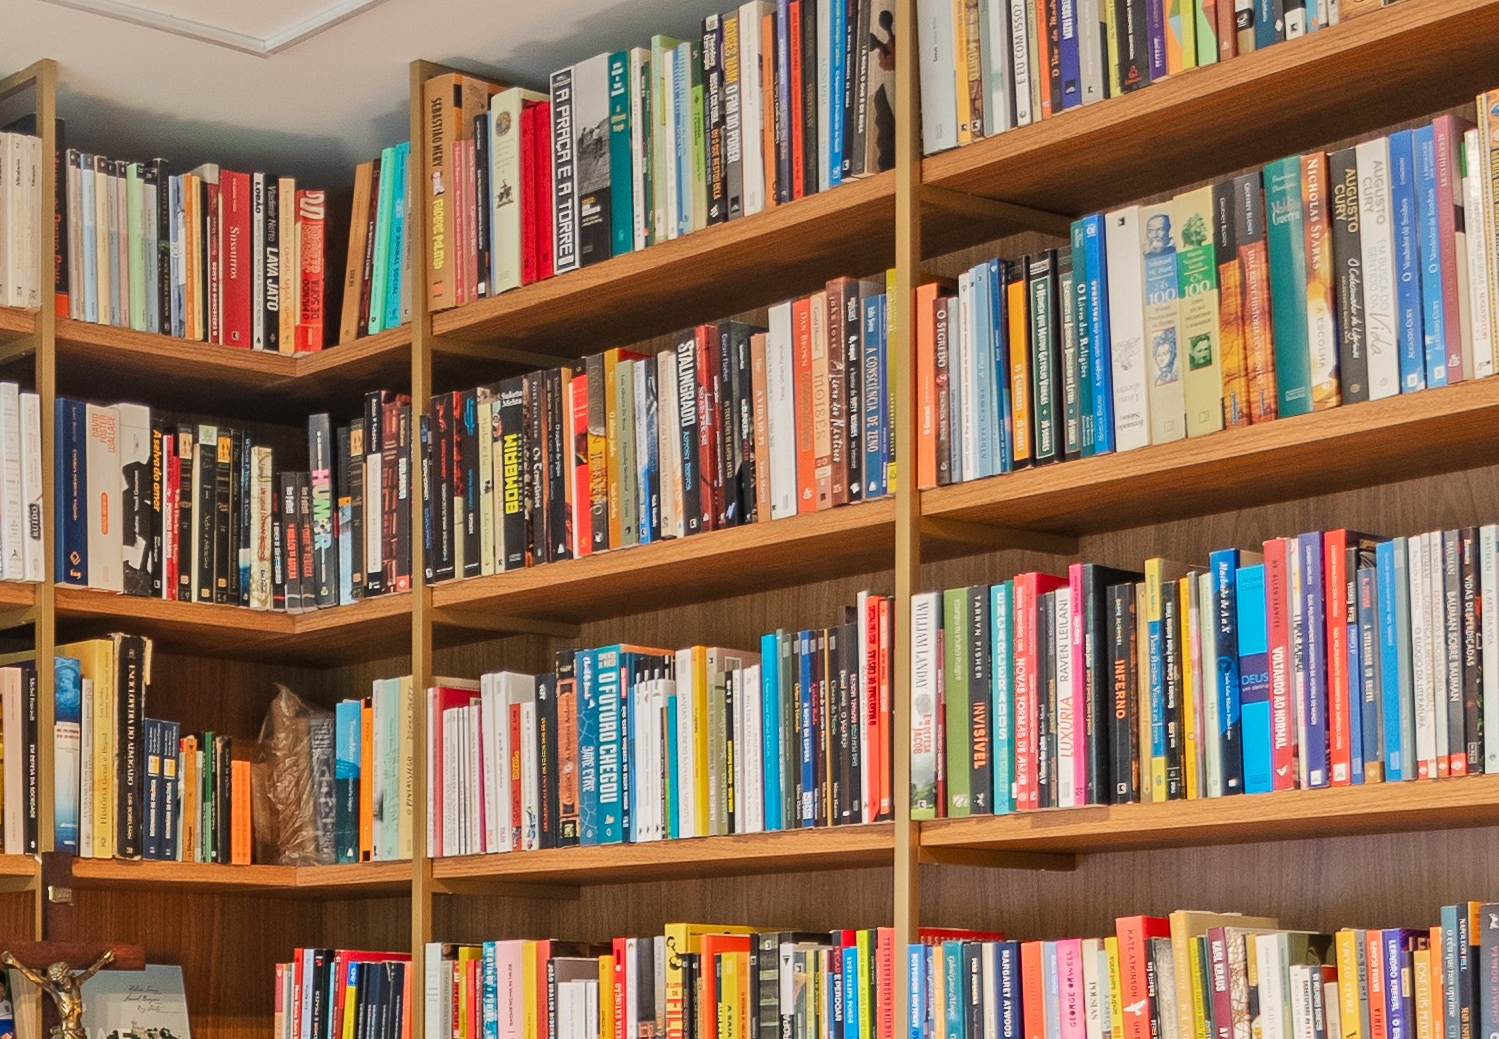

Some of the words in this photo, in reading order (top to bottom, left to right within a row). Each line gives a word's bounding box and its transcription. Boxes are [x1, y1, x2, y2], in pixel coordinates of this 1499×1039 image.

[555, 88, 570, 102] A
[555, 105, 571, 163] PRAÇA
[557, 166, 571, 179] E
[557, 182, 571, 196] A
[1307, 158, 1320, 222] NICHOLAS
[1334, 184, 1346, 222] CURY
[1346, 168, 1358, 232] AUGUSTO
[558, 198, 573, 257] TORRE
[1311, 225, 1322, 270] SPARKS
[266, 247, 278, 277] LAVA
[267, 279, 278, 311] JATO
[677, 339, 696, 427] STALINGRADO
[504, 433, 519, 515] BOMBAIM
[312, 468, 331, 551] HUMOR
[599, 671, 617, 682] O
[1114, 660, 1126, 719] INFERNO
[1241, 672, 1269, 685] DEUS
[1272, 646, 1285, 695] VOLTANDO
[599, 684, 617, 742] FUTURO
[1056, 696, 1074, 758] LUXÚRIA
[1274, 696, 1285, 708] AO
[974, 701, 989, 769] INVISÍVEL
[1274, 710, 1287, 749] NORMAL
[599, 743, 617, 803] CHEGOU
